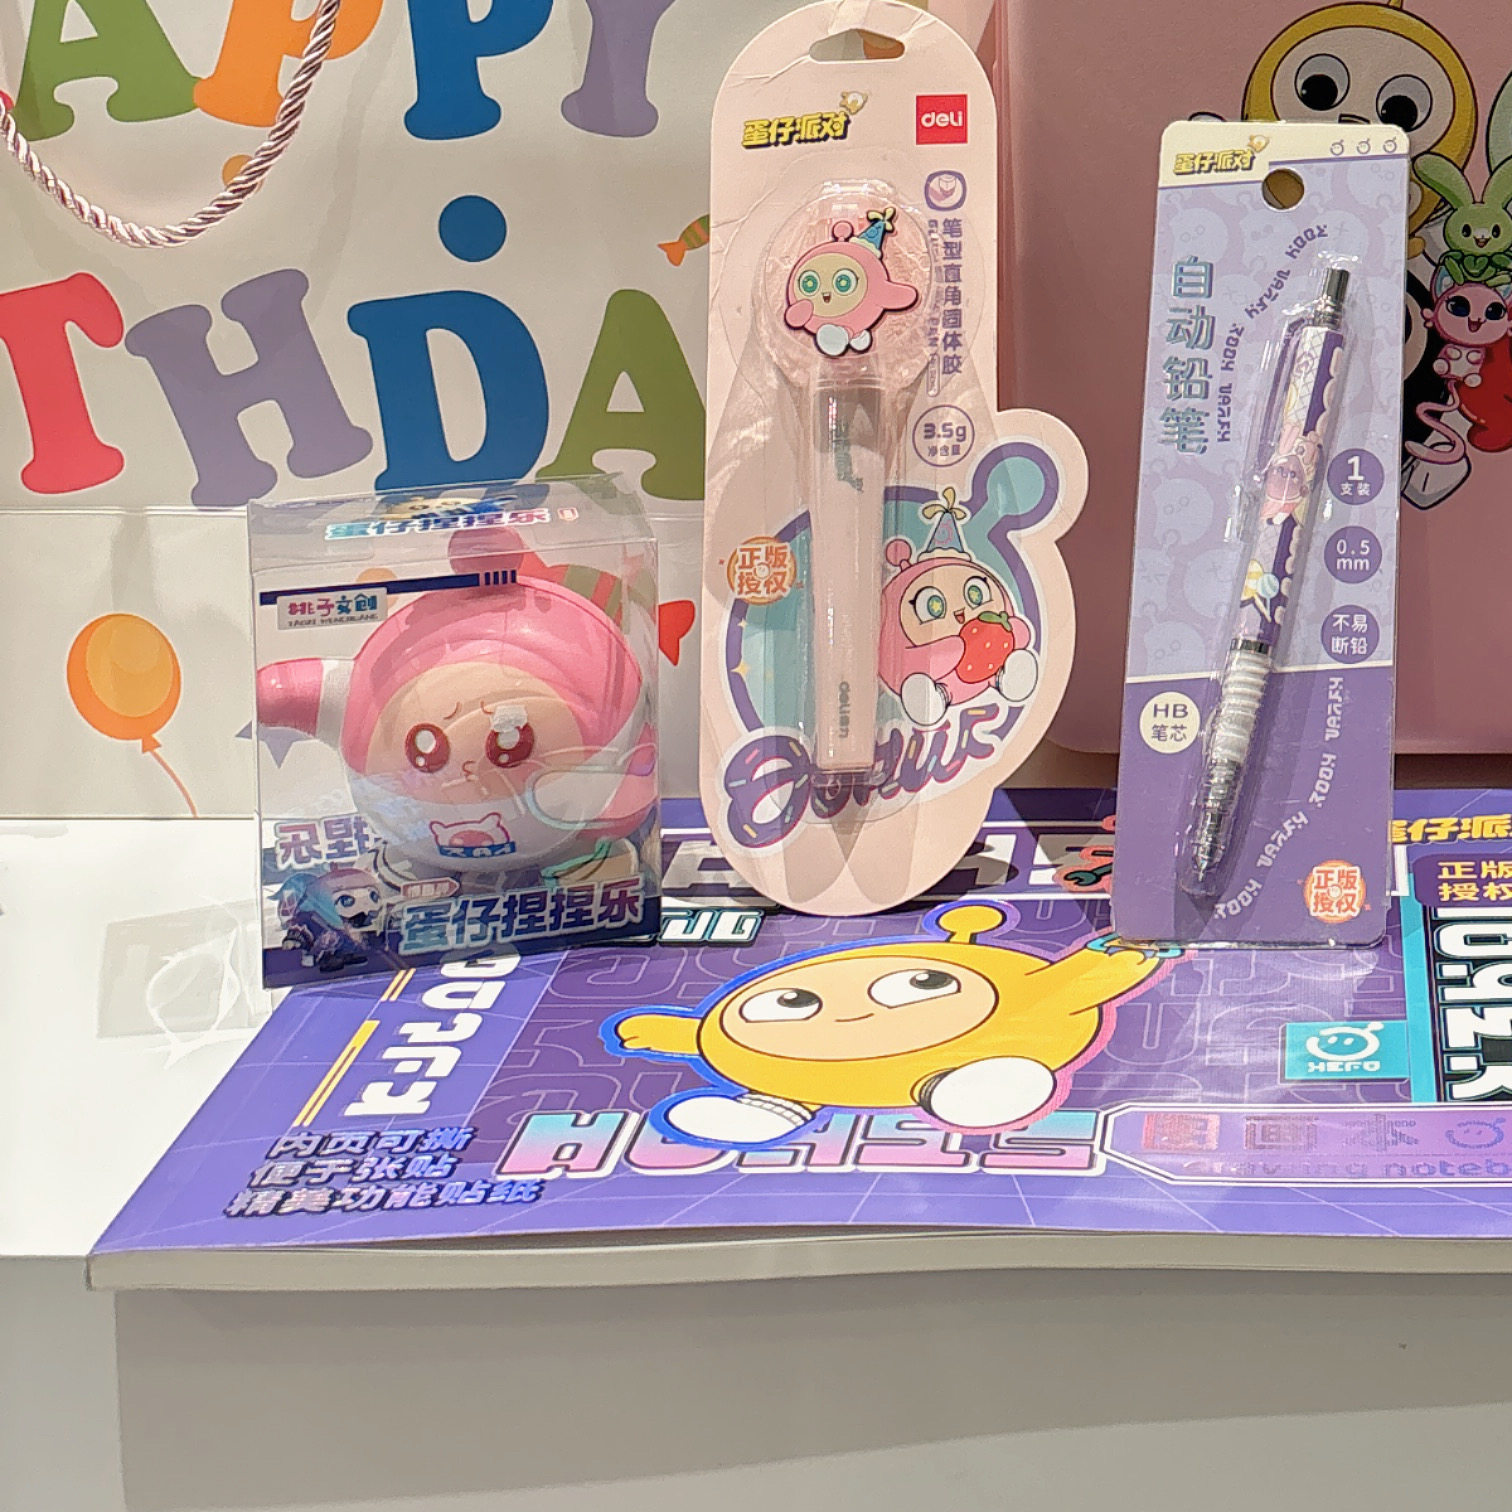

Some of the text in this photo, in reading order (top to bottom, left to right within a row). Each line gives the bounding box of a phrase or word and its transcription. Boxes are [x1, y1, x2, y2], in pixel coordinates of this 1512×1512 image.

[741, 109, 851, 150] 蛋仔派对
[921, 110, 963, 128] deli
[1173, 149, 1255, 176] 蛋仔派对
[941, 217, 963, 376] 笔型直角固体胶
[1159, 255, 1214, 455] 自动铅笔
[923, 422, 967, 443] 3.5g
[1347, 455, 1365, 481] 1
[1340, 482, 1371, 497] 支装
[738, 545, 789, 570] 正版
[1336, 557, 1370, 571] mm
[737, 571, 788, 596] 授权
[1332, 613, 1368, 634] 不易
[1331, 635, 1368, 656] 断铅
[1153, 703, 1189, 719] HB
[1151, 724, 1188, 742] 笔芯
[1314, 868, 1359, 890] 正版
[402, 876, 643, 952] 蛋仔捏捏乐
[1312, 890, 1359, 914] 授权
[267, 1126, 476, 1160] 内页可撕
[247, 1153, 458, 1187] 便于张贴
[225, 1179, 546, 1218] 精美功能贴纸
